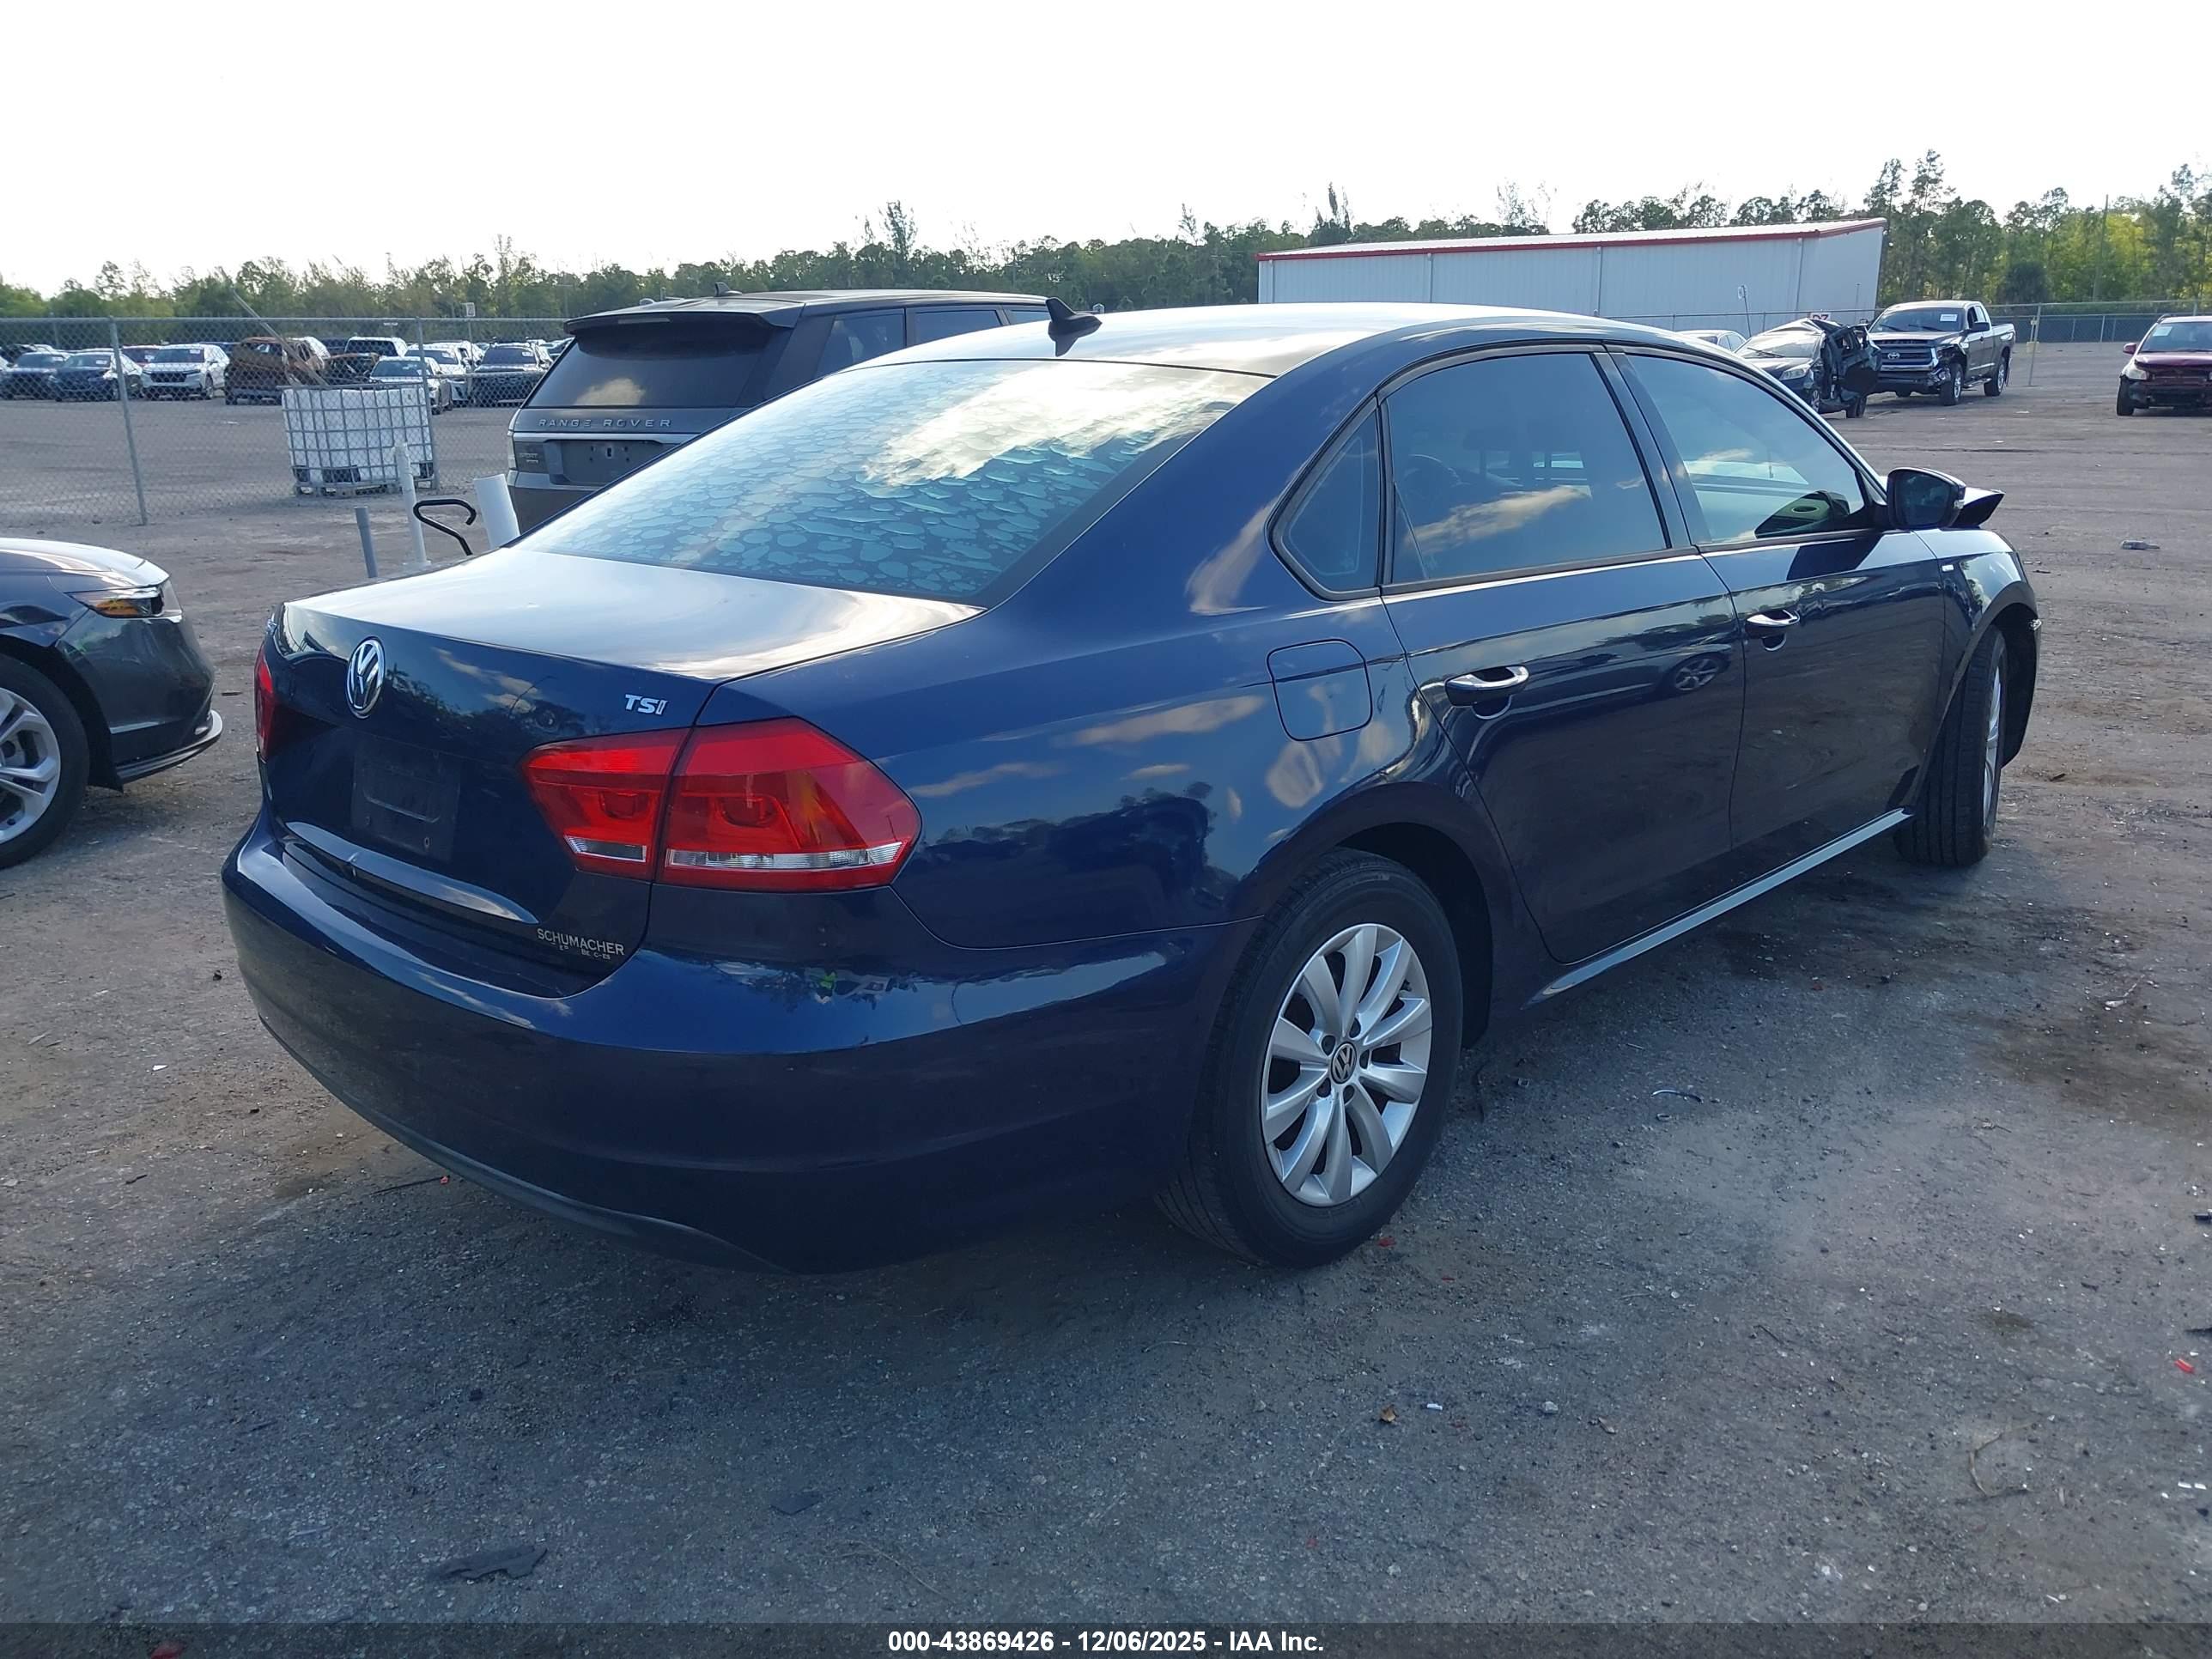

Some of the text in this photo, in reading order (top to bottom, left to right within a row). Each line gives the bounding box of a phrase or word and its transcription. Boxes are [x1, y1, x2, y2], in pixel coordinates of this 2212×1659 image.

[538, 418, 672, 428] RANGE ROVER
[347, 638, 385, 715] VW
[537, 927, 625, 956] SCHUMACHER
[1332, 1042, 1357, 1084] VW
